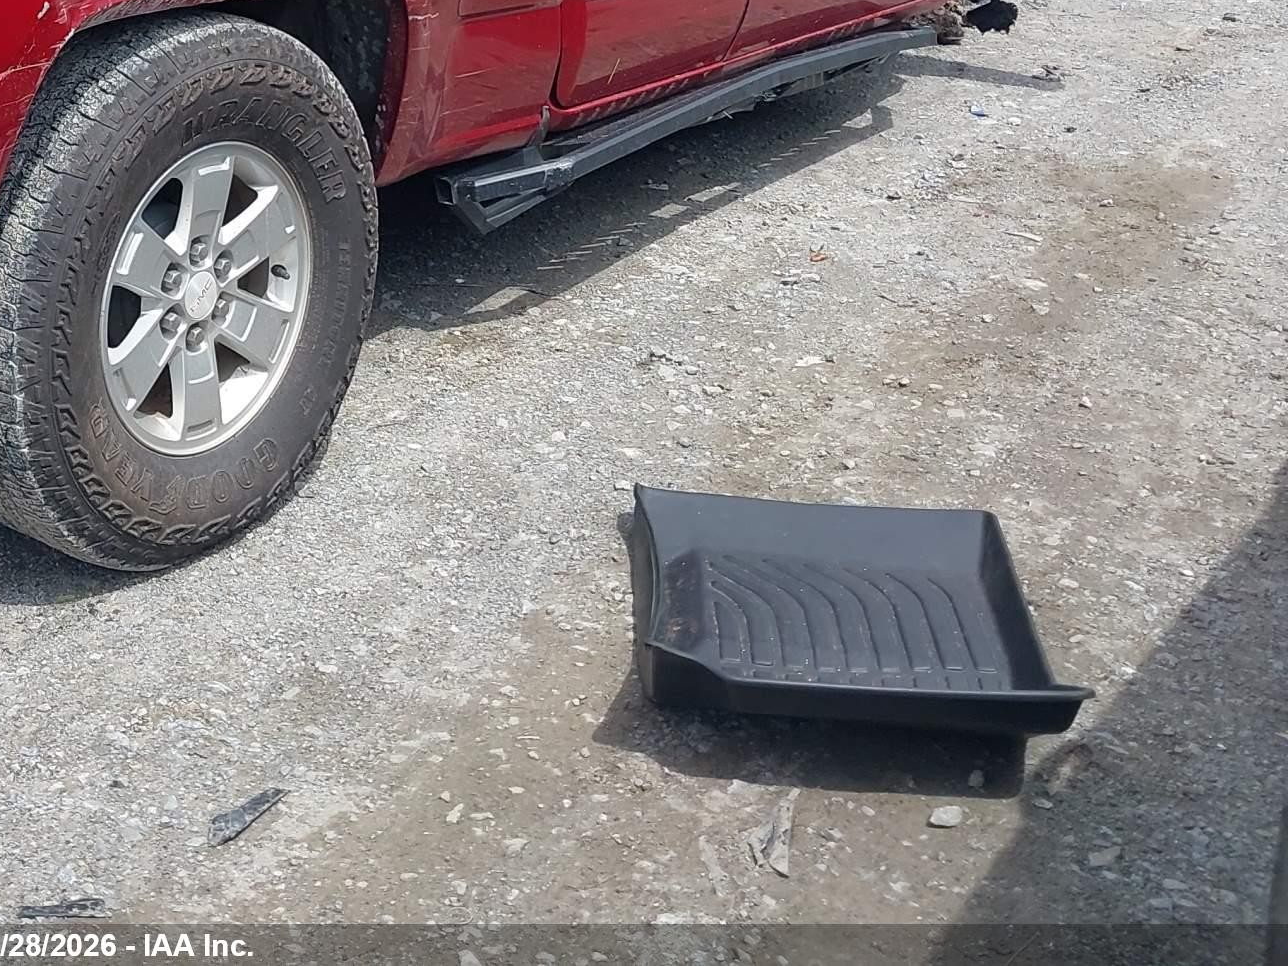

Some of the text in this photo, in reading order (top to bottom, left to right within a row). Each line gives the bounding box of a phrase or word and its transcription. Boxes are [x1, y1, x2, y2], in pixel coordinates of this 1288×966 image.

[181, 97, 347, 204] WRANGLER
[189, 276, 213, 313] GMC
[89, 398, 280, 515] GOODYEAR
